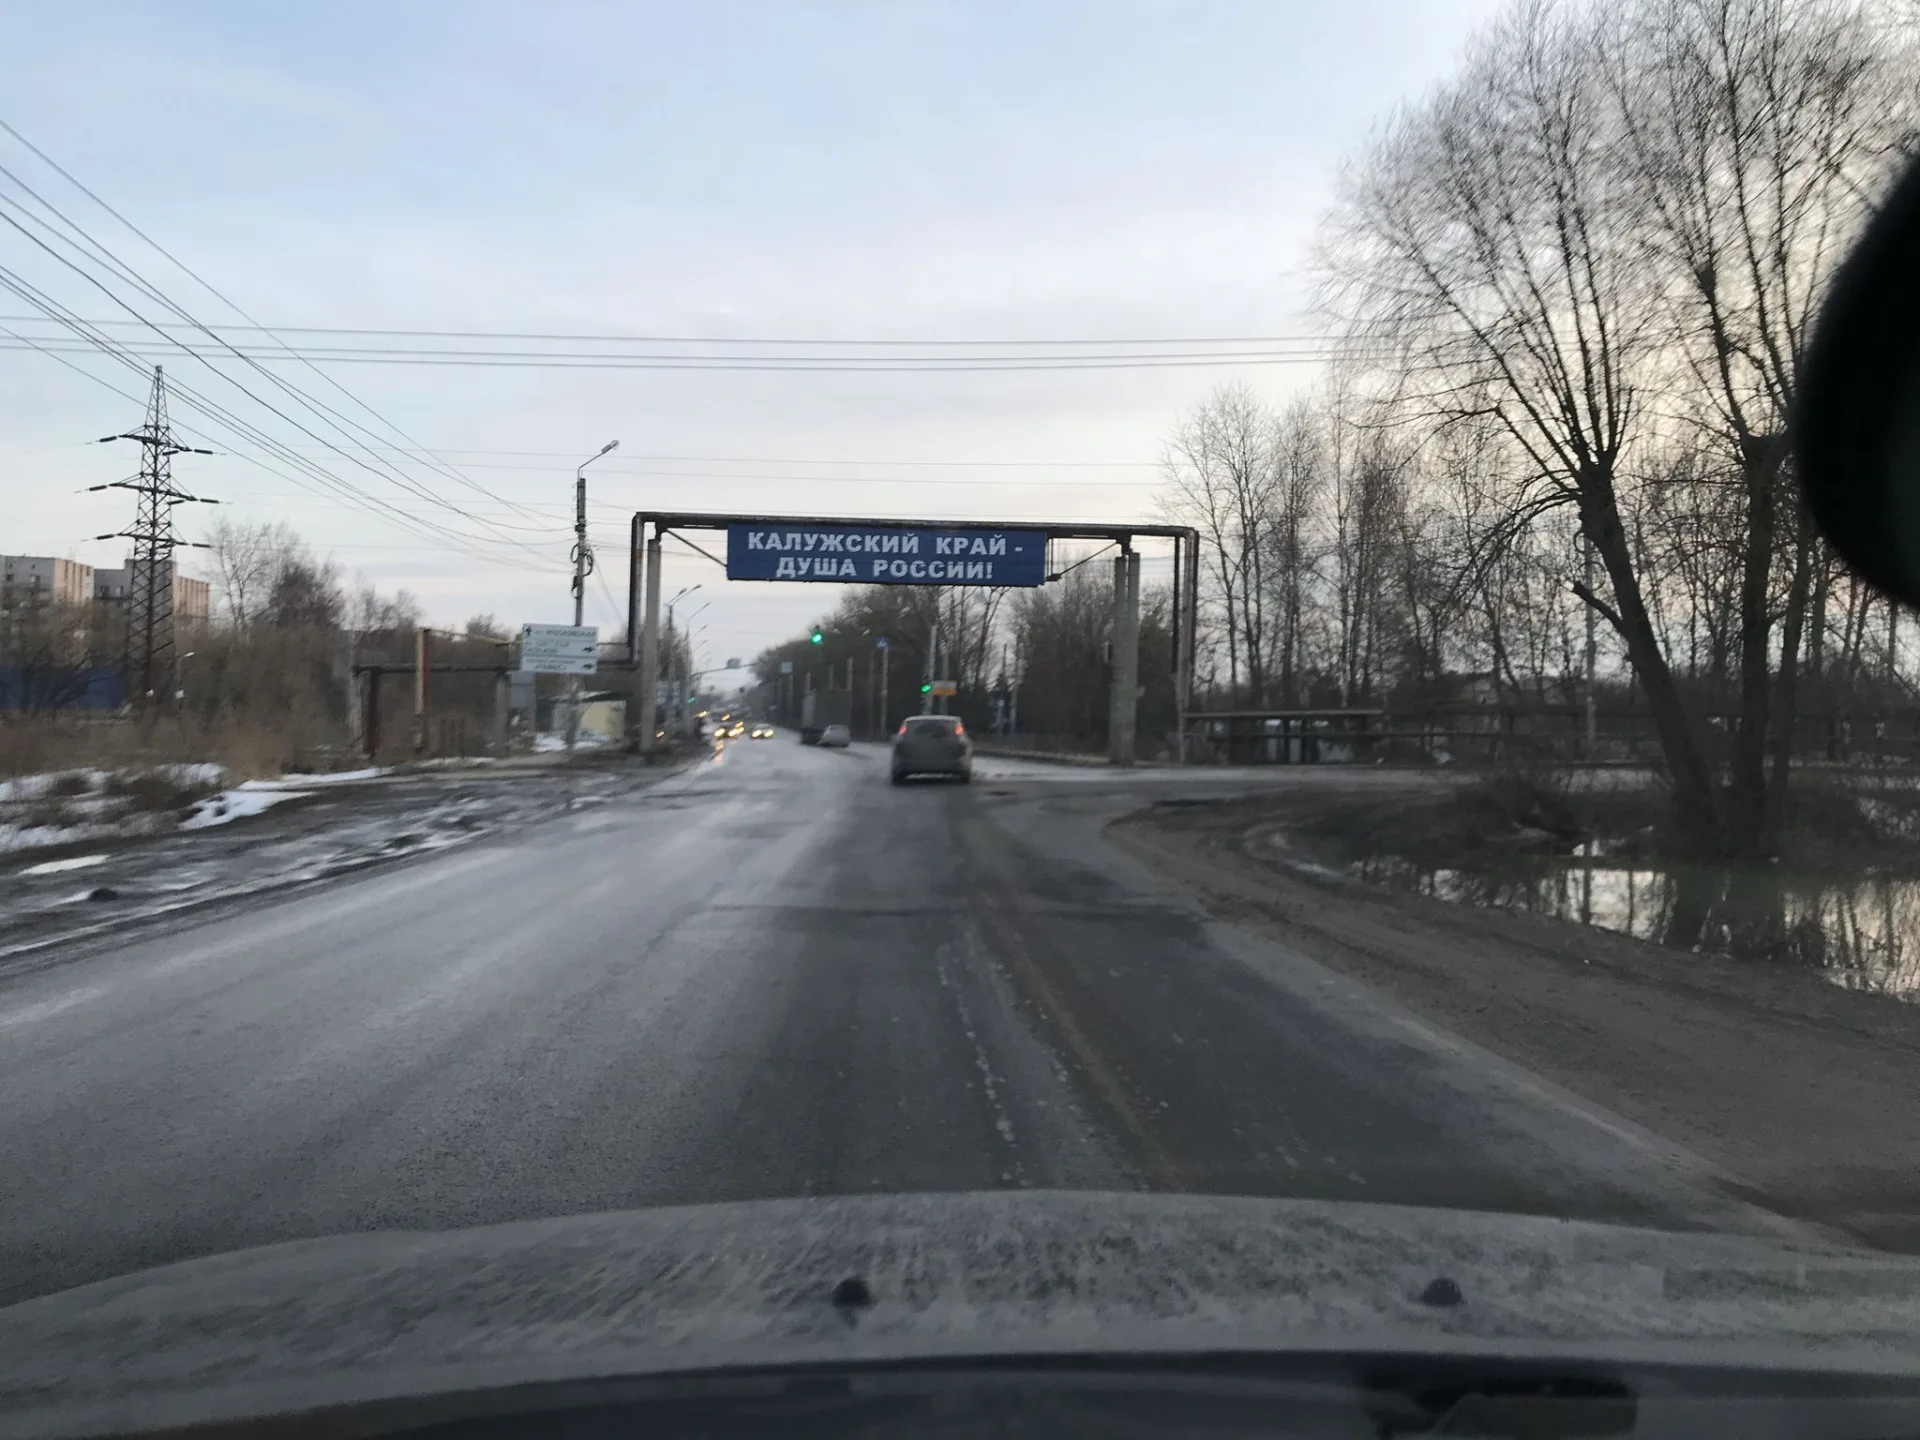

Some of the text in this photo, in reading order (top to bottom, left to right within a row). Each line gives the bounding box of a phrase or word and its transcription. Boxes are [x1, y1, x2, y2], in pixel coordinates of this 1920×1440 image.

[748, 532, 919, 554] КАЛУЖСКИЙ
[935, 534, 1006, 555] КРАЙ
[776, 557, 993, 579] ДУША РОССИИ!
